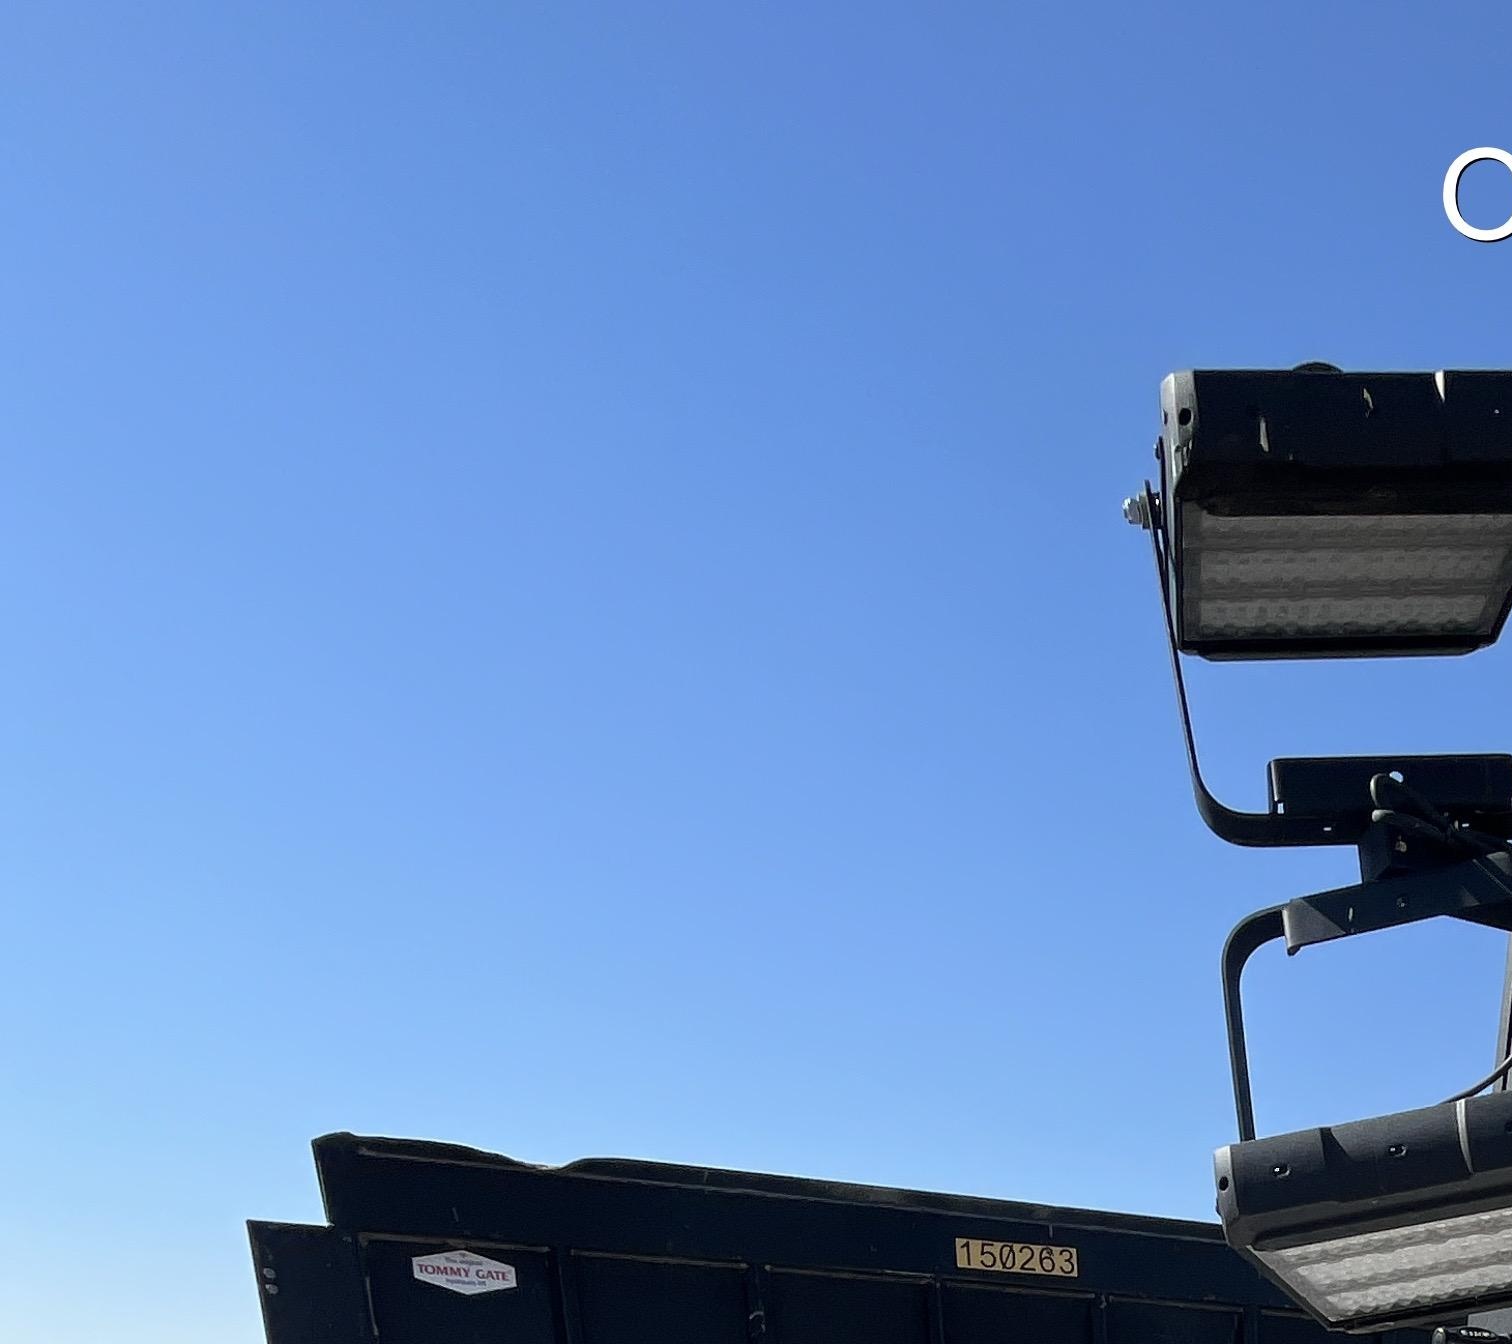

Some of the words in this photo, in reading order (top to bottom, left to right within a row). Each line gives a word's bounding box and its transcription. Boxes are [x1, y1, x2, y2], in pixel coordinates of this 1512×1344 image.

[959, 1241, 1075, 1275] 150263
[417, 1263, 471, 1280] TOMMY
[475, 1269, 511, 1283] GATE
